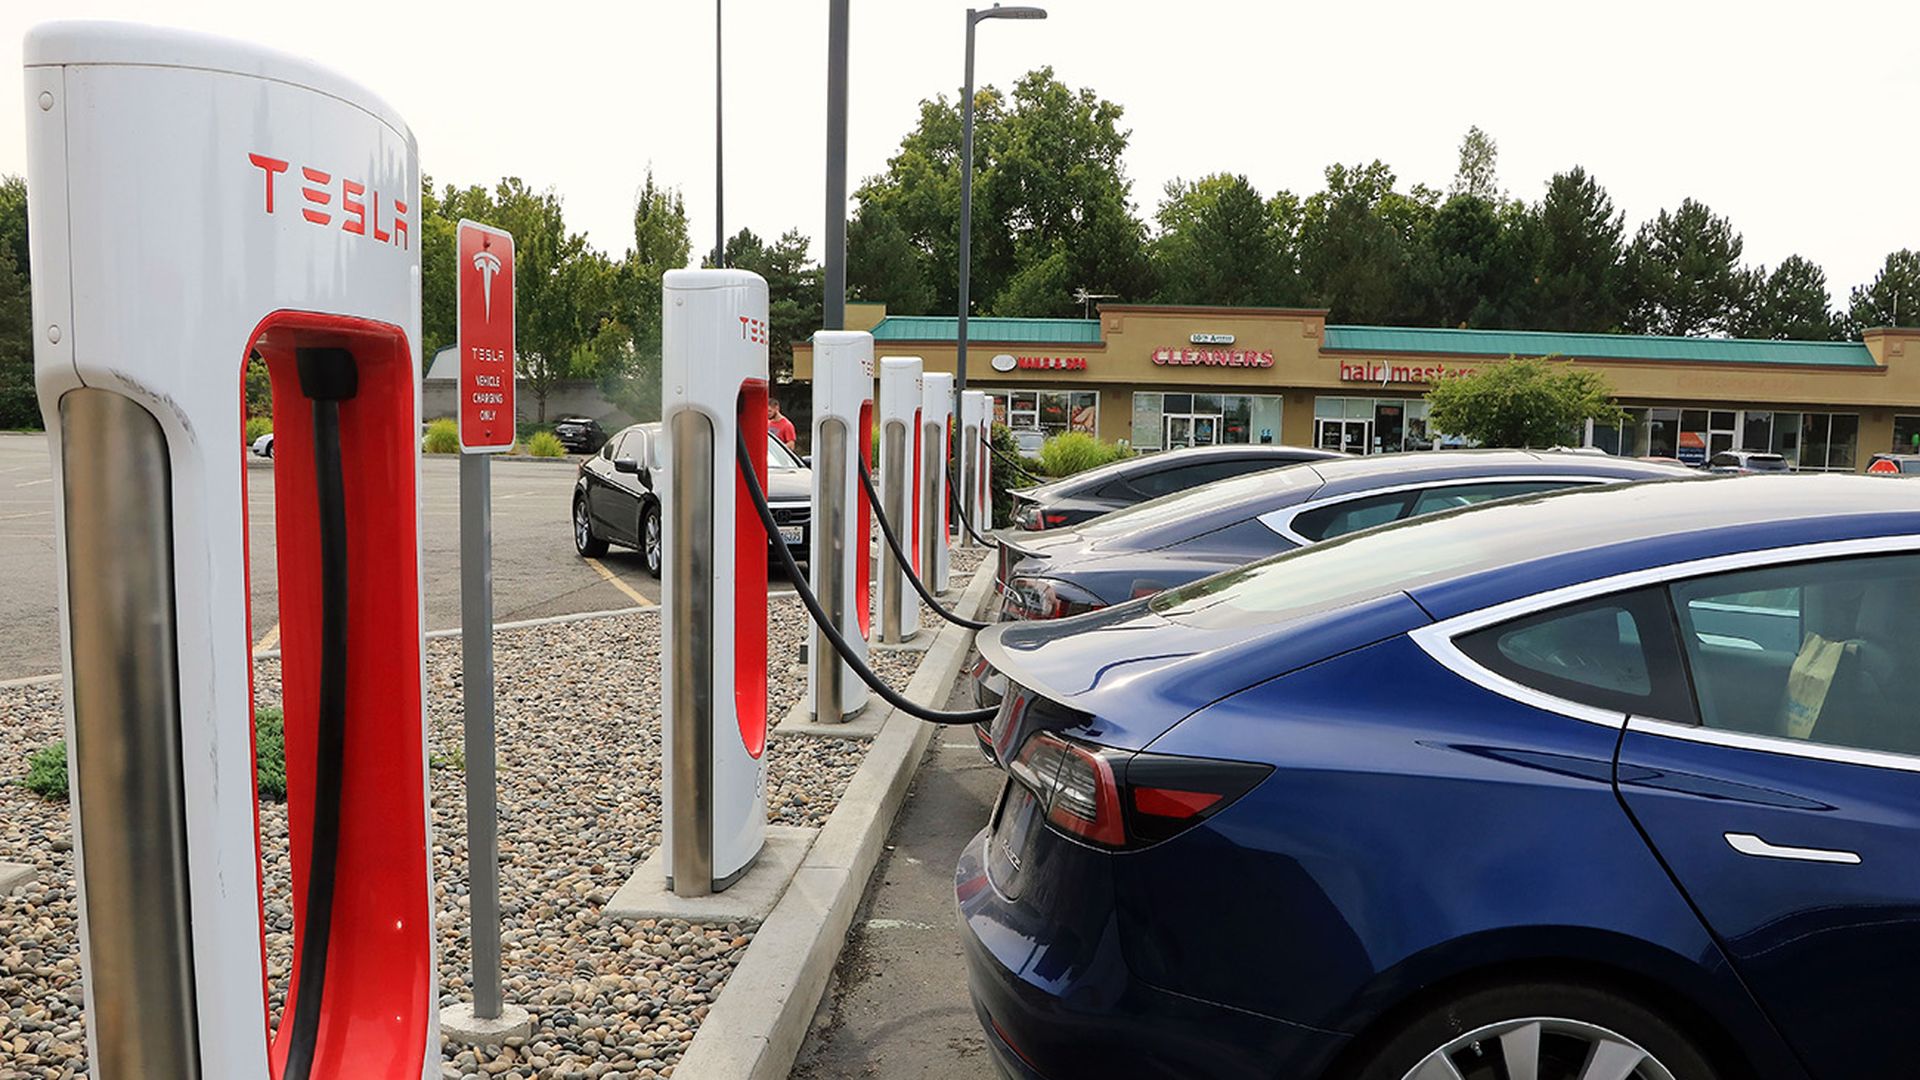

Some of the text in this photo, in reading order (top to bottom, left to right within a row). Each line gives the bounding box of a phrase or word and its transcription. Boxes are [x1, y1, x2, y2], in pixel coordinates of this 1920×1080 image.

[248, 152, 408, 250] TESLA
[471, 347, 505, 362] TESLA
[1152, 346, 1275, 368] CLEANERS
[1018, 356, 1087, 370] NAILS & SPA
[475, 375, 500, 387] VEHICLE
[472, 392, 504, 404] CHARGING
[480, 409, 497, 421] ONLY
